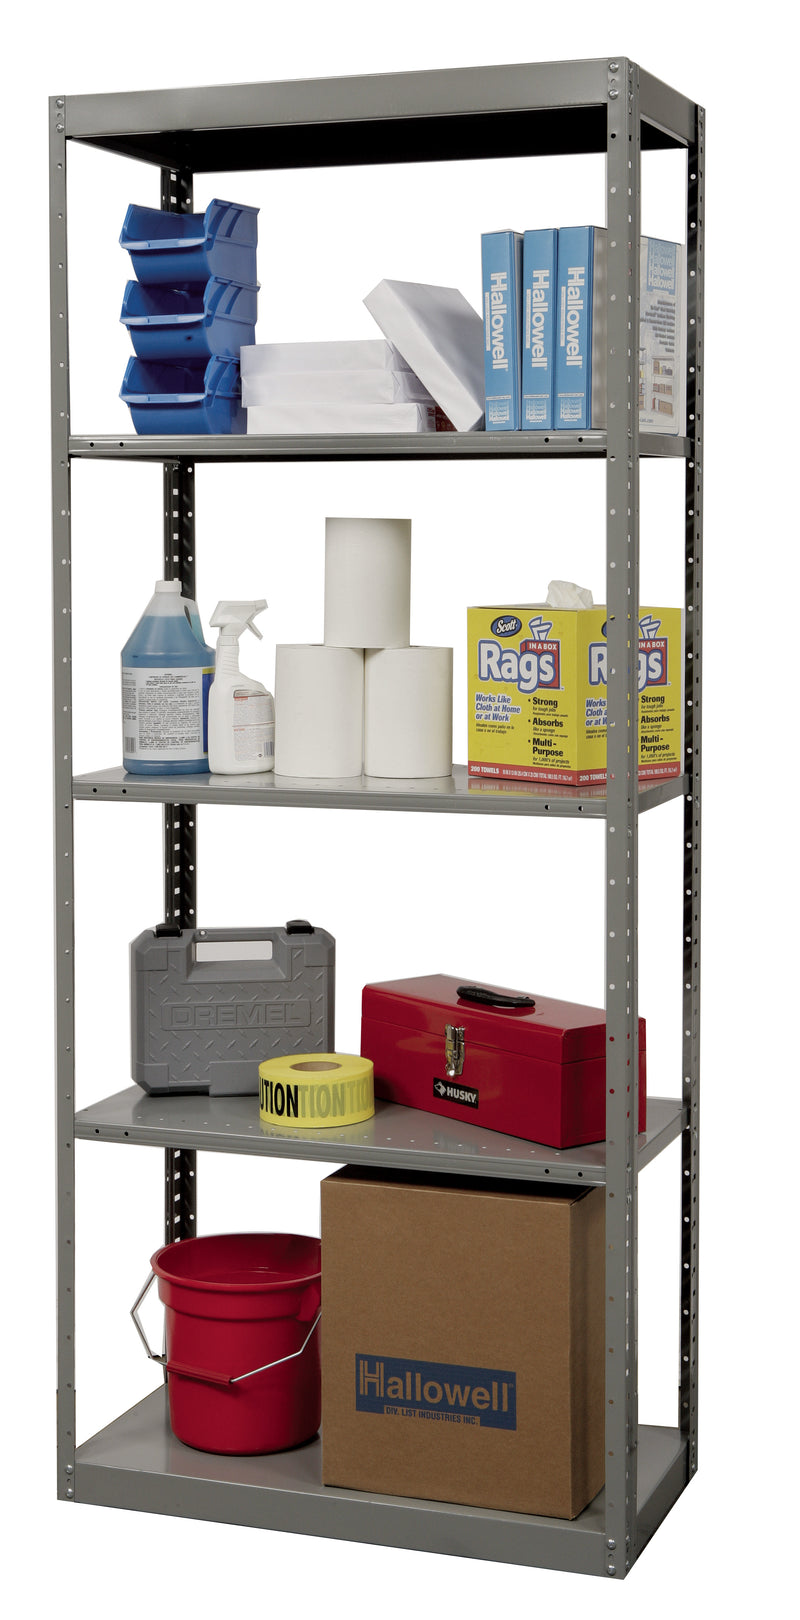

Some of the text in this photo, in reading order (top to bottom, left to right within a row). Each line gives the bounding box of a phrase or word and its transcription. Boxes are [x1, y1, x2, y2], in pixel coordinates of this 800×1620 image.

[490, 272, 508, 370] Hallowell
[531, 269, 550, 368] Hallowell
[566, 267, 585, 366] Hallowell
[496, 619, 518, 633] Scott
[543, 643, 557, 651] BOX
[479, 640, 556, 694] Rags
[589, 643, 663, 692] Rgs
[476, 693, 511, 704] Works Like
[533, 696, 558, 708] Strong
[586, 699, 606, 707] Works
[641, 695, 665, 704] Strong
[475, 702, 521, 714] Cloth at Home
[585, 708, 601, 717] Cloth
[484, 712, 491, 721] at
[492, 712, 510, 721] Work
[533, 717, 564, 727] Absorbs
[594, 718, 601, 726] at
[641, 714, 670, 723] Absorbs
[533, 747, 564, 757] Purpose
[641, 744, 670, 753] Purpose
[481, 766, 499, 774] TOWELS
[171, 1003, 301, 1026] DREMEL
[447, 1086, 476, 1103] HUSKY
[359, 1360, 509, 1412] Hallowell
[386, 1406, 479, 1426] DIV. LIST INDUSTRIES INC.
